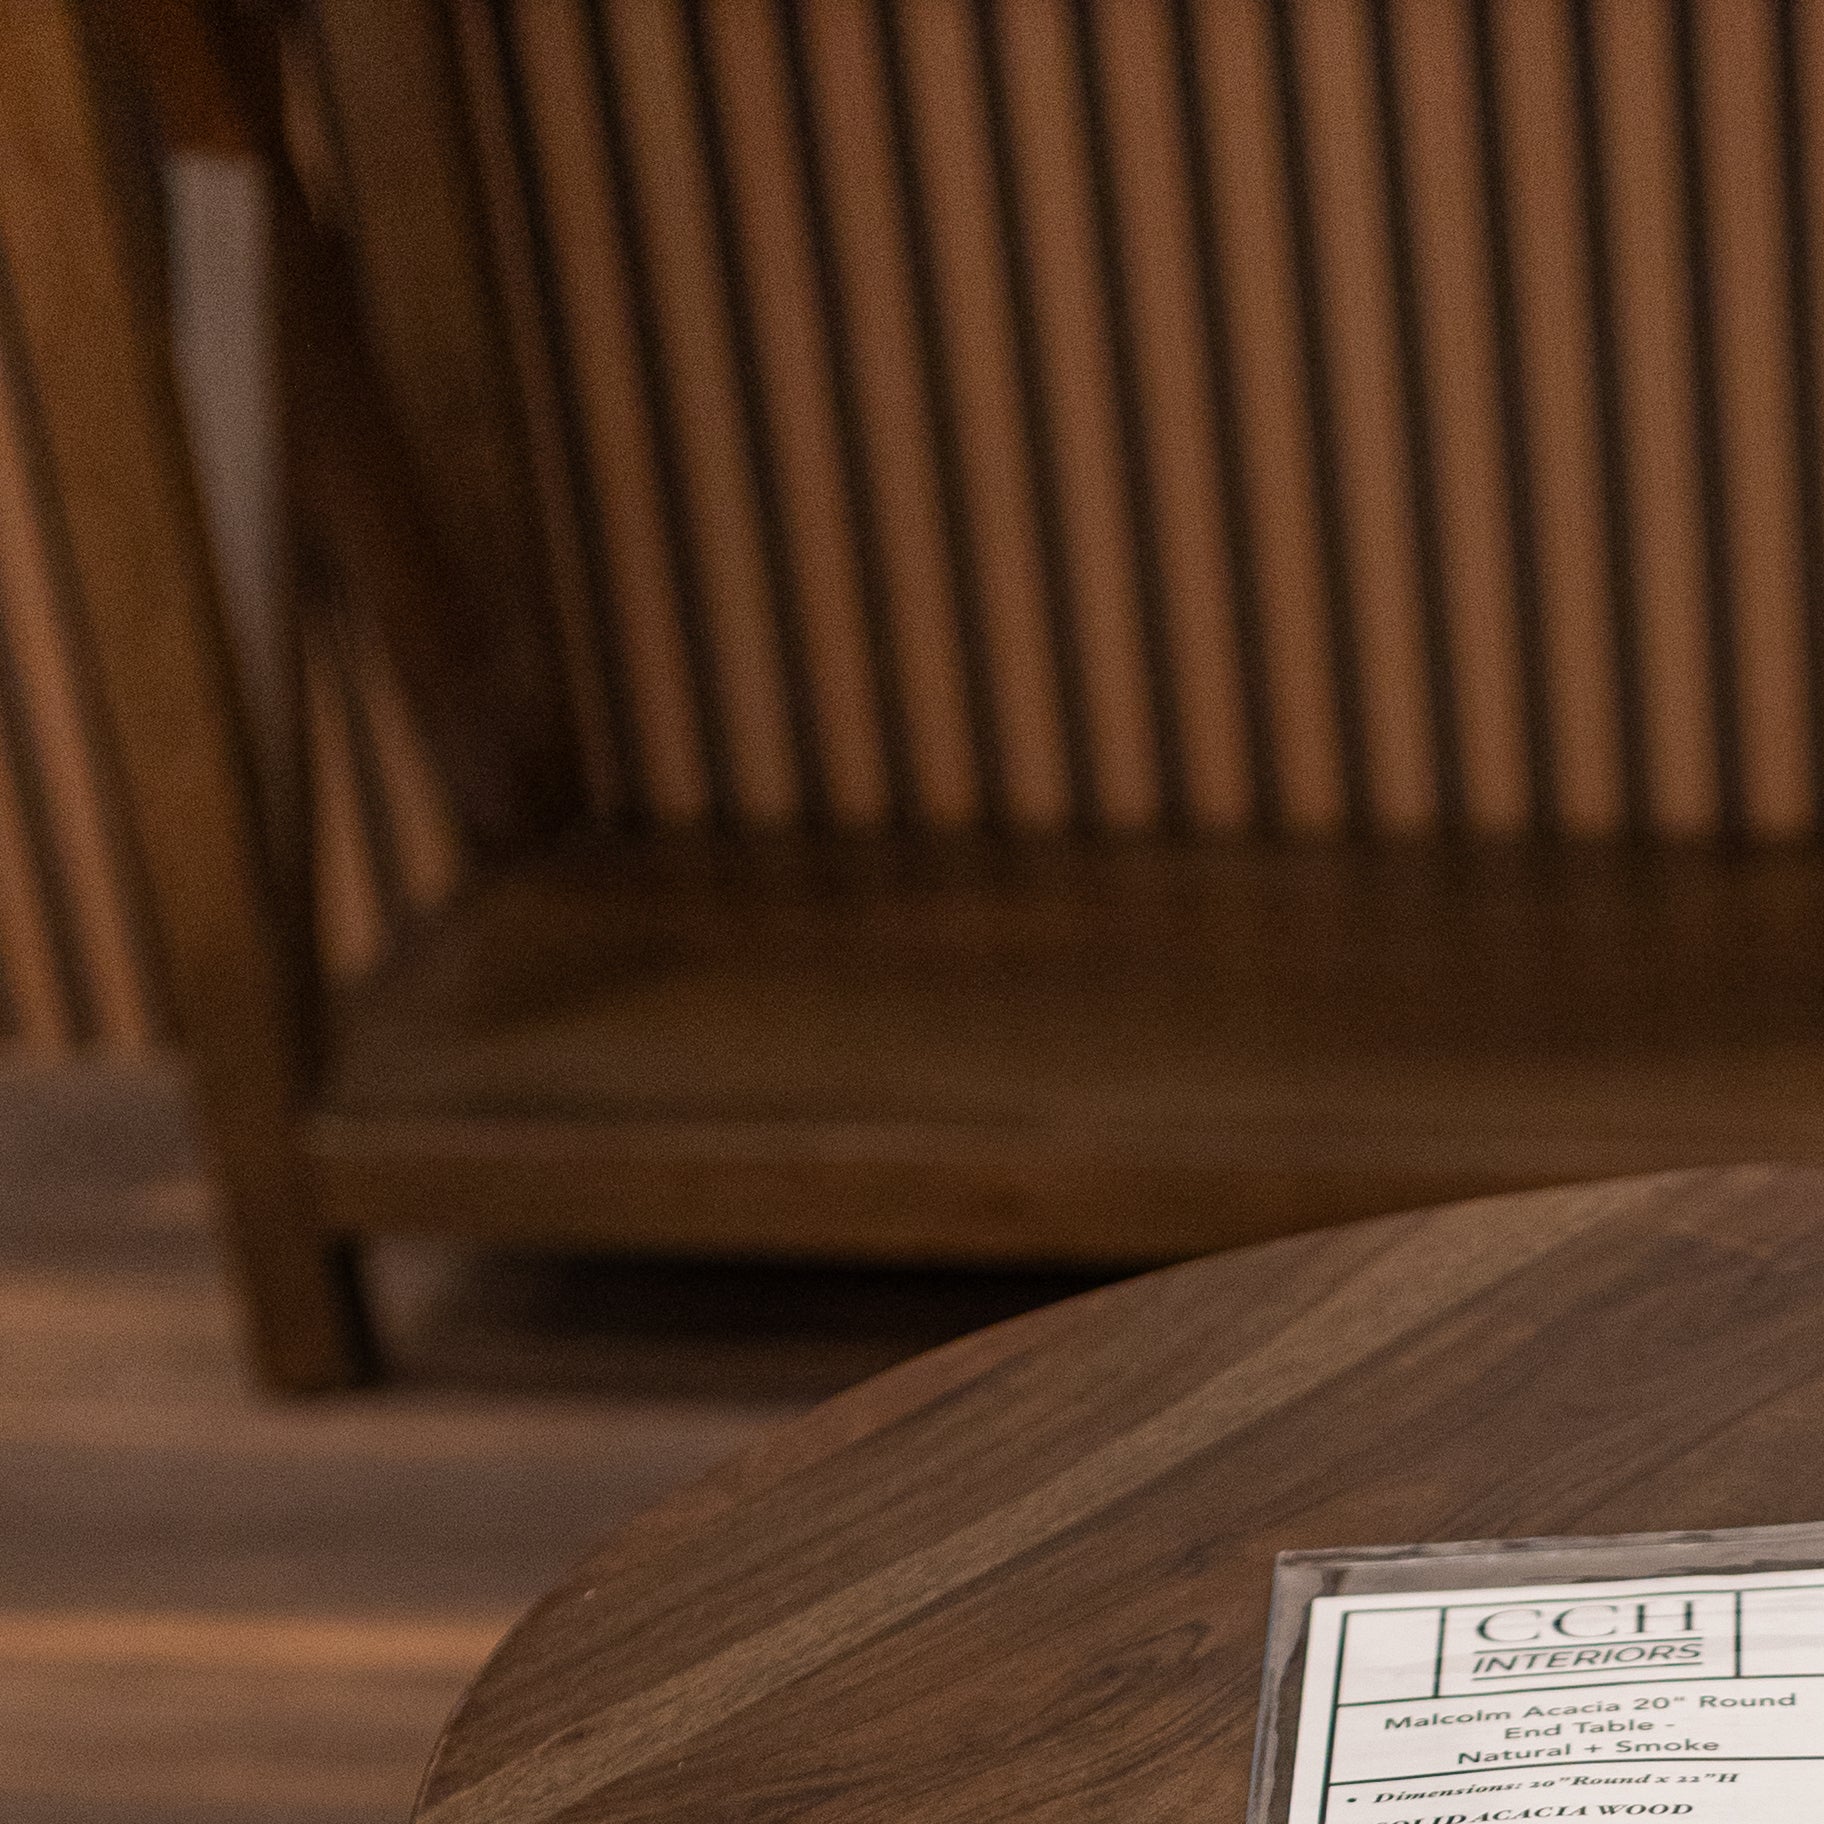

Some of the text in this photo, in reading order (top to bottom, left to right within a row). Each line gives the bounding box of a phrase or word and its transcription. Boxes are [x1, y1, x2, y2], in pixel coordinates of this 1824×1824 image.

[1476, 1600, 1703, 1642] CCH
[1472, 1643, 1703, 1674] INTERIORS
[1384, 1693, 1797, 1730] Malcolm Acacia 20" Round
[1504, 1723, 1562, 1740] End
[1572, 1719, 1654, 1734] Table
[1458, 1738, 1720, 1764] Natural + Smoke
[1373, 1782, 1523, 1803] Dimensions:
[1654, 1776, 1670, 1784] x
[1467, 1805, 1588, 1823] ACACIA
[1598, 1803, 1694, 1817] WOOD
